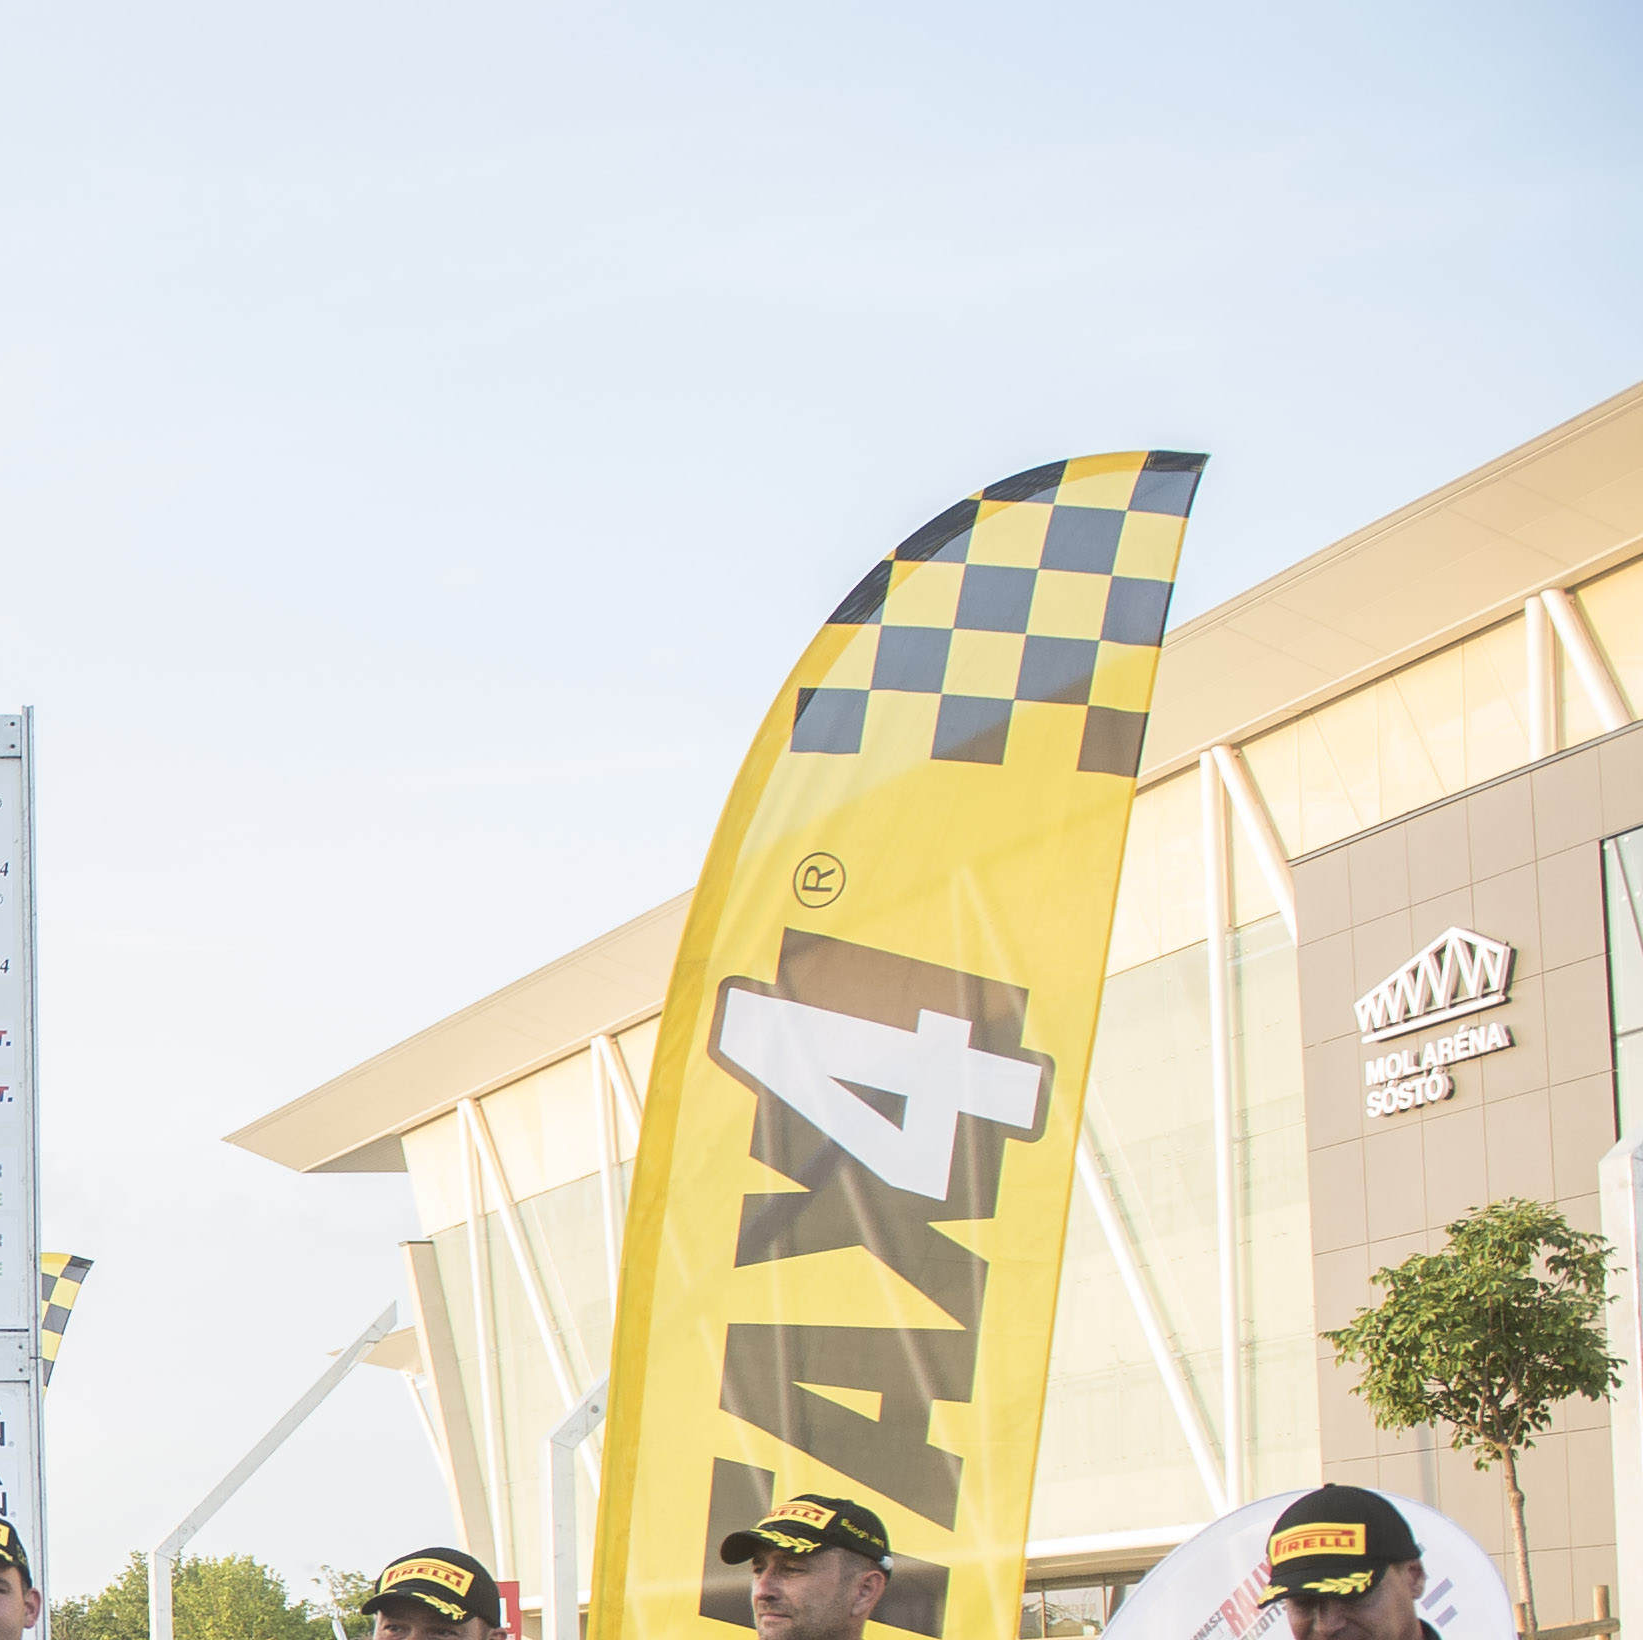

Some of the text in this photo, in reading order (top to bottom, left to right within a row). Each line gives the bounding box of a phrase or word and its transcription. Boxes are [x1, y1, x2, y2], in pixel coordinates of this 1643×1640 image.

[1365, 1023, 1512, 1086] MOL ARÉNA
[1365, 1069, 1453, 1118] SÓSTÓ
[1274, 1528, 1357, 1558] PIRELLI
[383, 1561, 465, 1591] PIRELLI
